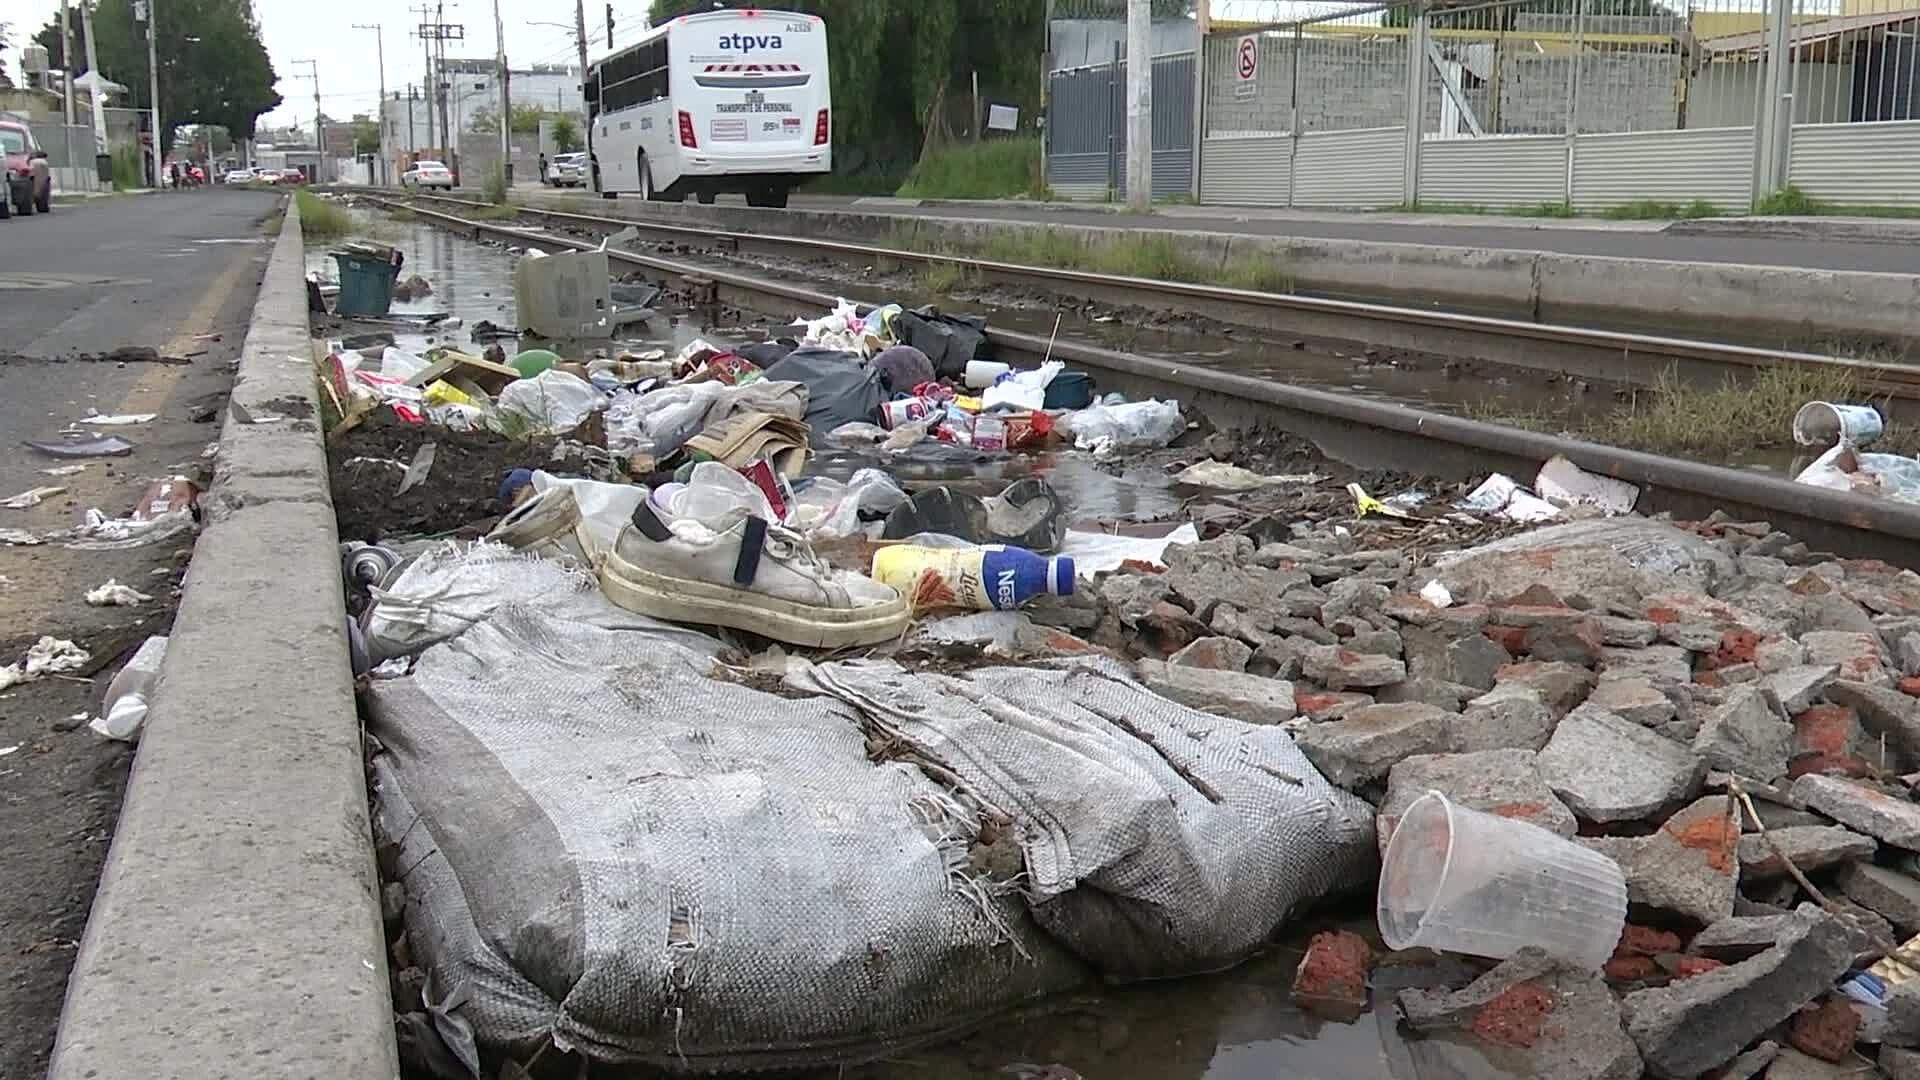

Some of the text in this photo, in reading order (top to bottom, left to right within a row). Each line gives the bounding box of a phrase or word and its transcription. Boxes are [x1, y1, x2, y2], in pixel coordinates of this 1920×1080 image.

[719, 33, 782, 53] atpva
[716, 103, 753, 113] TRANSPORTE
[764, 102, 792, 112] PERSONAL
